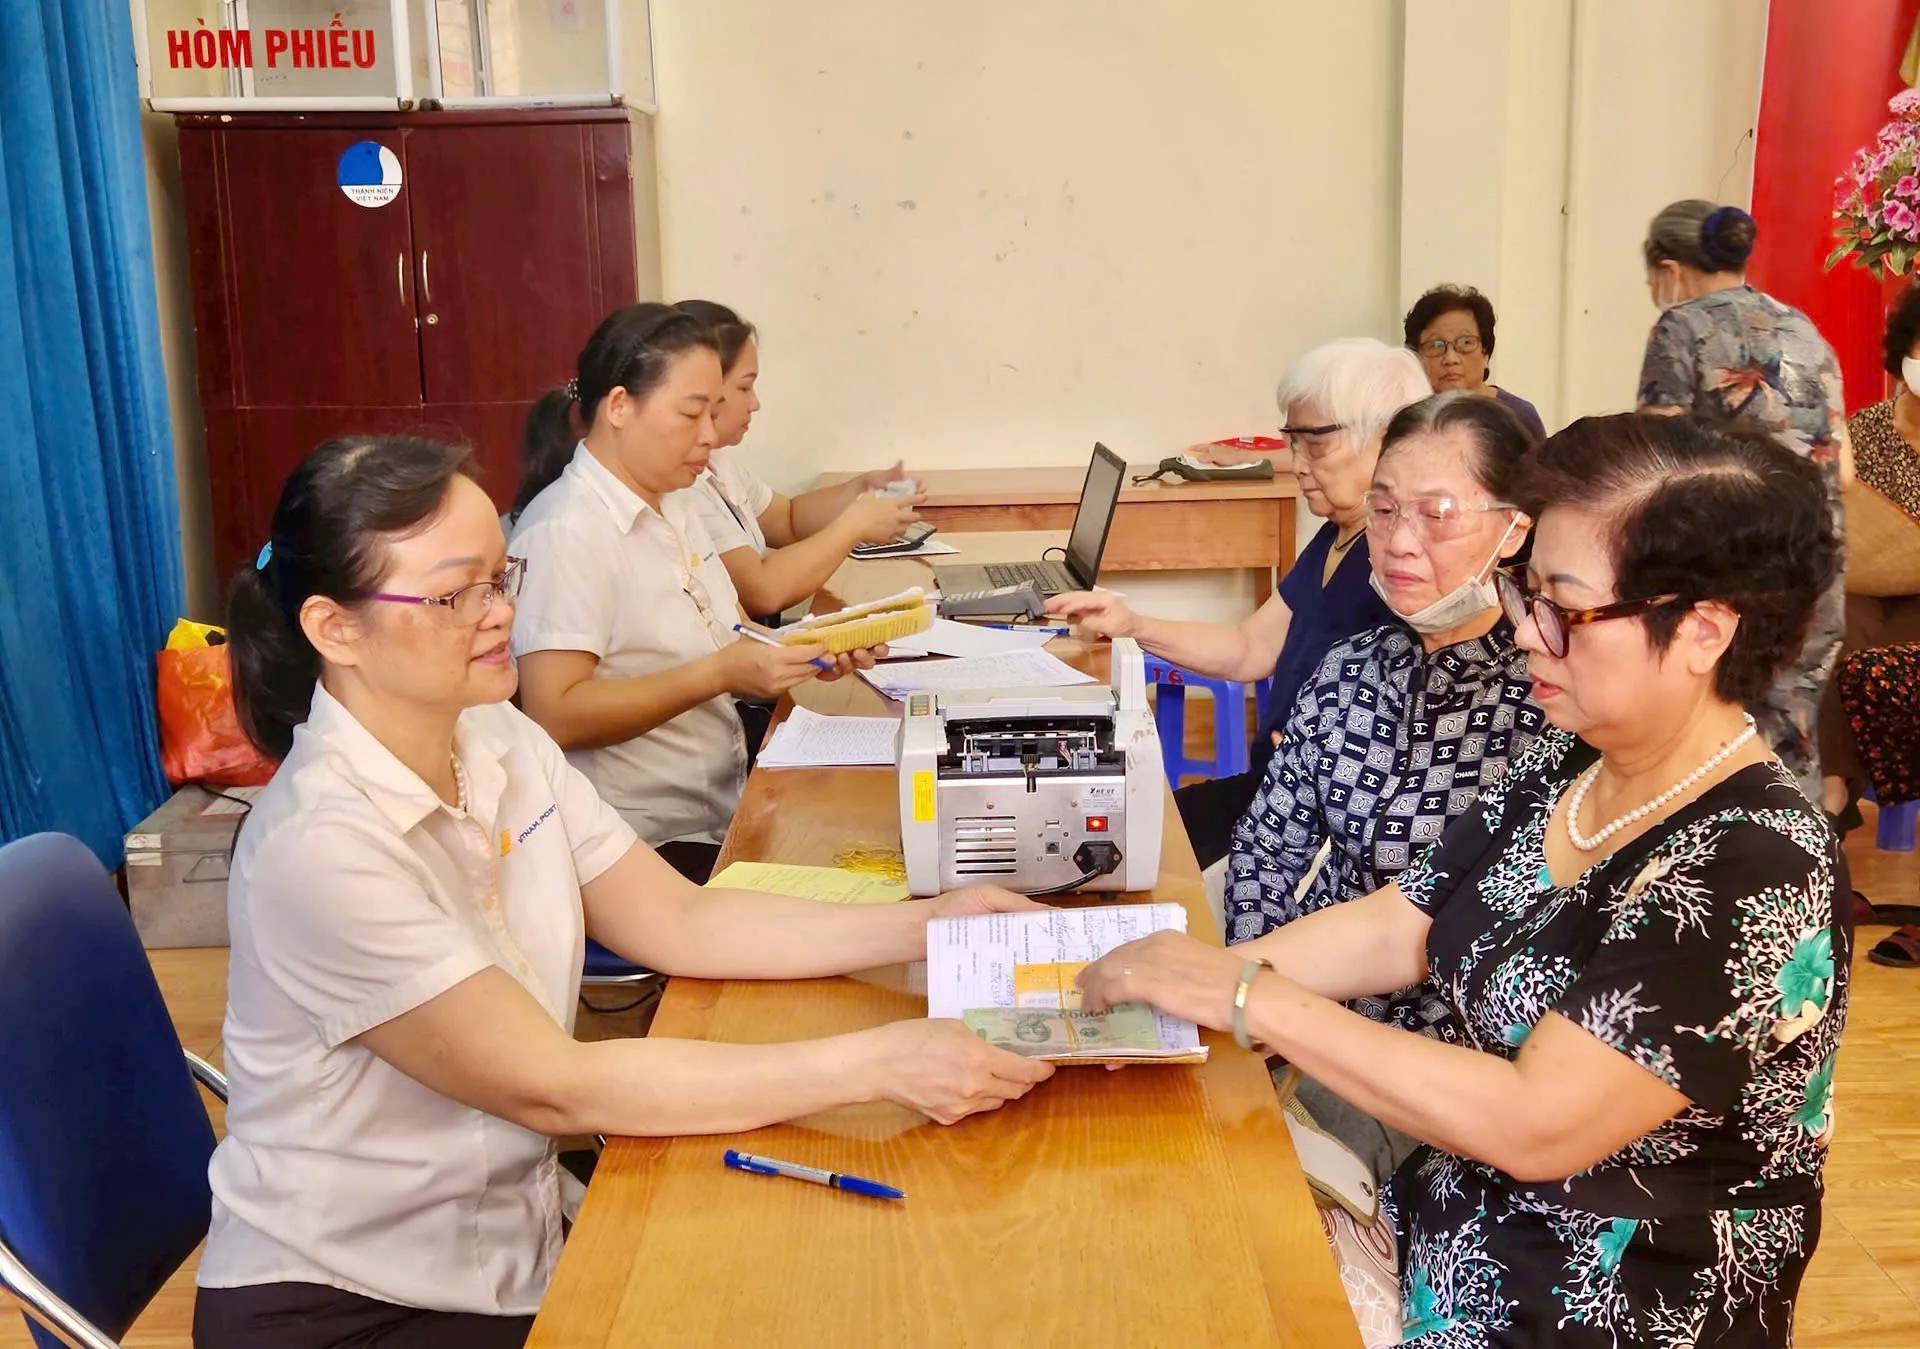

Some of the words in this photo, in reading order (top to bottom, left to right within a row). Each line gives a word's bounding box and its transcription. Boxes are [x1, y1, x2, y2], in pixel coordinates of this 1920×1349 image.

[167, 17, 253, 69] HÒM
[265, 12, 376, 69] PHIẾU
[539, 803, 558, 822] POST
